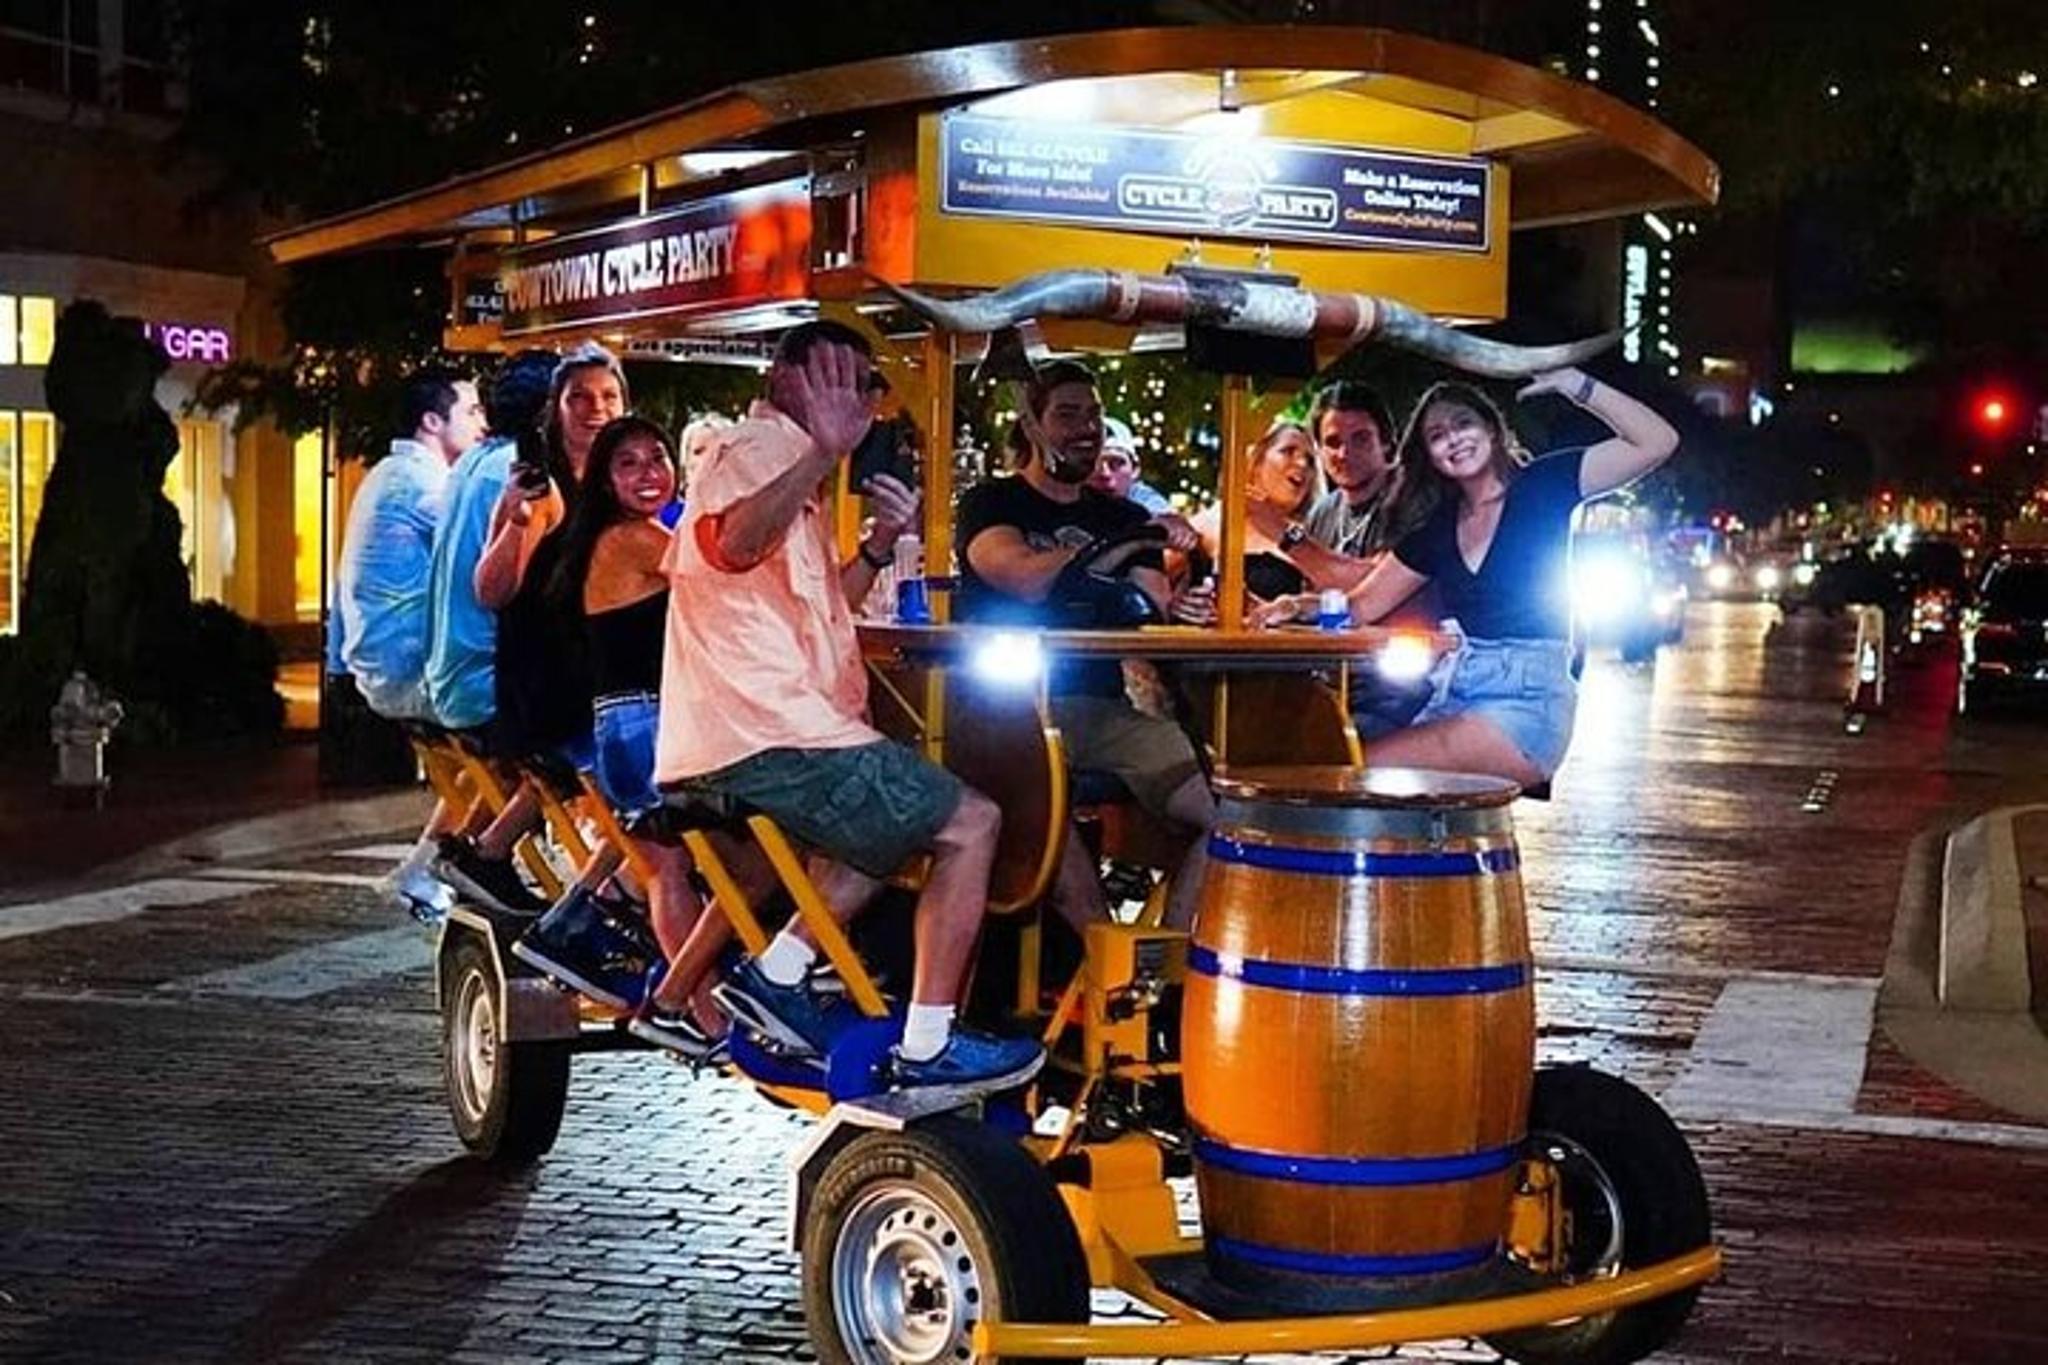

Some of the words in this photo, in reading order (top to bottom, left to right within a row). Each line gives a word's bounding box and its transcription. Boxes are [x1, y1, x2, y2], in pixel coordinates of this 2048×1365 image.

[1125, 184, 1203, 206] CYCLE
[1344, 168, 1385, 186] Make
[1387, 175, 1397, 188] a
[1399, 174, 1480, 195] Reservation
[1413, 193, 1461, 216] Today!
[602, 238, 664, 297] CYCLE
[667, 224, 738, 283] PARTY
[162, 326, 229, 361] GAR
